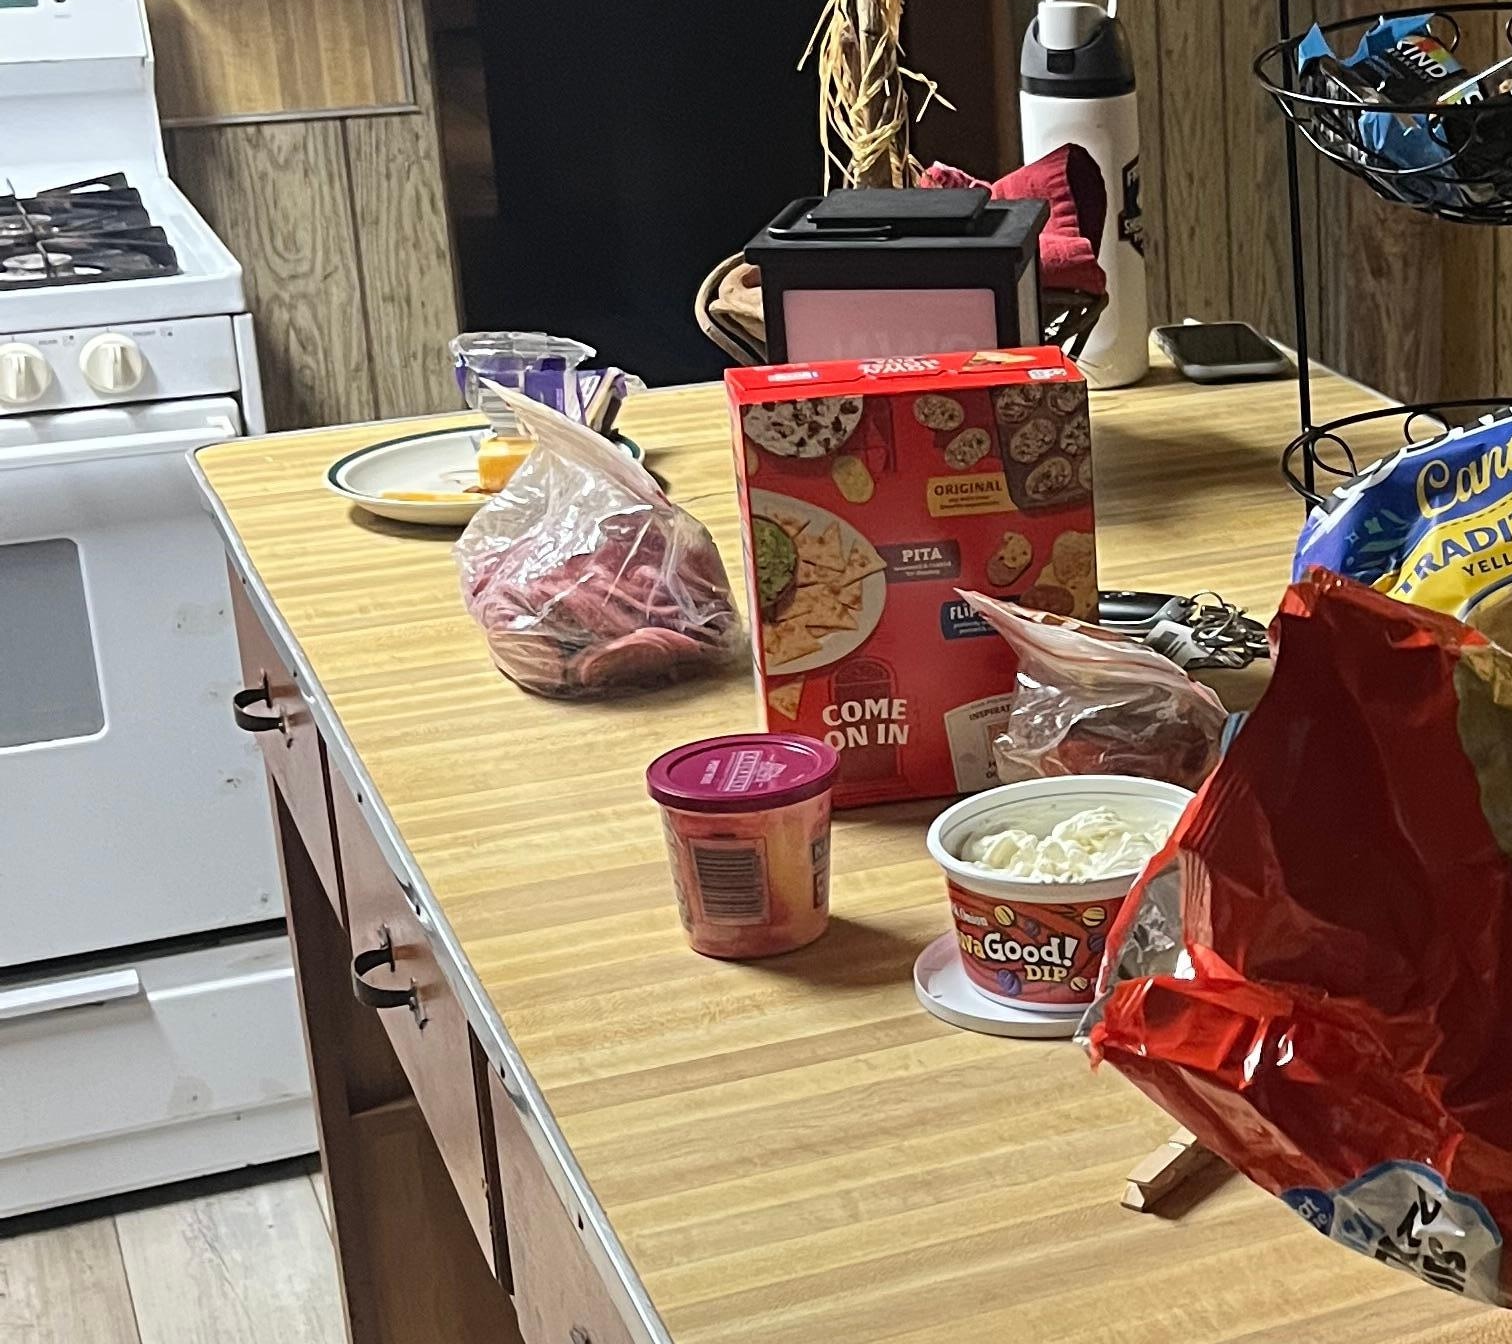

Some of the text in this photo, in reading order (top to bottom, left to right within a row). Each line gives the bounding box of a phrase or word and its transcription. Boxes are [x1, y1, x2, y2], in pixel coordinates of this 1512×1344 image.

[934, 479, 1003, 497] ORIGINAL
[901, 547, 943, 563] PITA
[822, 698, 909, 728] COME
[968, 702, 1011, 722] INSPIRAT
[824, 724, 909, 753] ON IN
[1024, 964, 1068, 982] DIP
